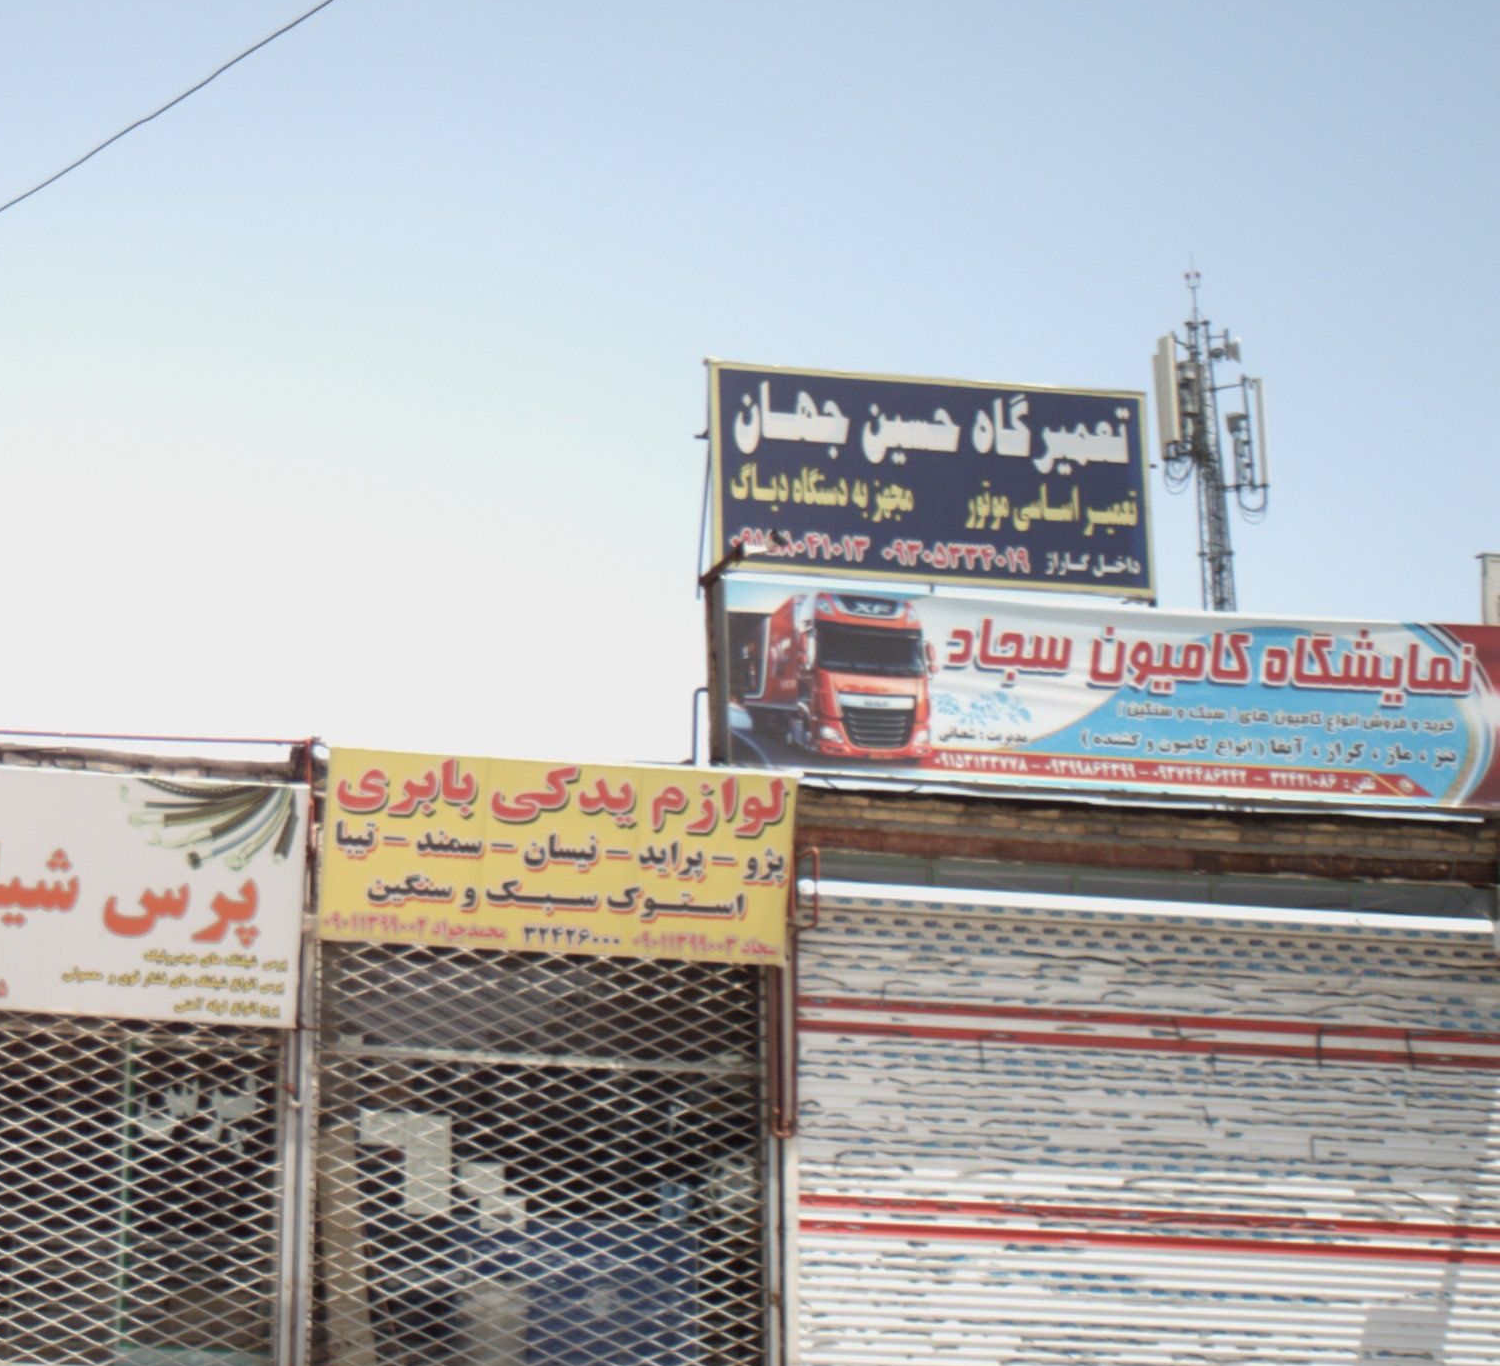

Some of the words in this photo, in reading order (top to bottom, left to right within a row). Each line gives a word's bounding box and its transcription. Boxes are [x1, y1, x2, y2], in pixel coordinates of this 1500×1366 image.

[733, 379, 850, 460] جهان
[861, 402, 961, 465] حسین
[971, 393, 1031, 457] گاه
[1032, 406, 1131, 474] تعمیر
[730, 462, 789, 512] دیاگ
[792, 465, 848, 508] دستگاه
[852, 481, 870, 521] به
[871, 480, 915, 523] مجهز
[964, 480, 1010, 530] موتور
[1013, 483, 1080, 531] اساسی
[1083, 489, 1138, 536] تعمیر
[1092, 554, 1142, 577] داخل
[947, 619, 1075, 686] سجاد
[1087, 626, 1253, 694] کامیون
[1263, 629, 1478, 707] نمایشگاه
[1273, 711, 1322, 728] کامیون
[1326, 713, 1359, 732] انواع
[1362, 712, 1407, 730] فروش
[1423, 719, 1455, 733] خرید
[336, 757, 478, 818] بابری
[491, 765, 636, 827] یدکی
[651, 775, 787, 837] لوازم
[335, 819, 377, 859] تیبا
[415, 827, 485, 858] سمند
[522, 832, 598, 873] نیسان
[638, 840, 706, 879] پراید
[366, 873, 455, 905] سنگین
[742, 850, 787, 885] پژو
[103, 876, 261, 948] پرس
[461, 885, 479, 912] و
[485, 879, 599, 916] سبک
[607, 886, 748, 921] استوک
[523, 925, 621, 947] ۳۲۴۲۶۰۰۰
